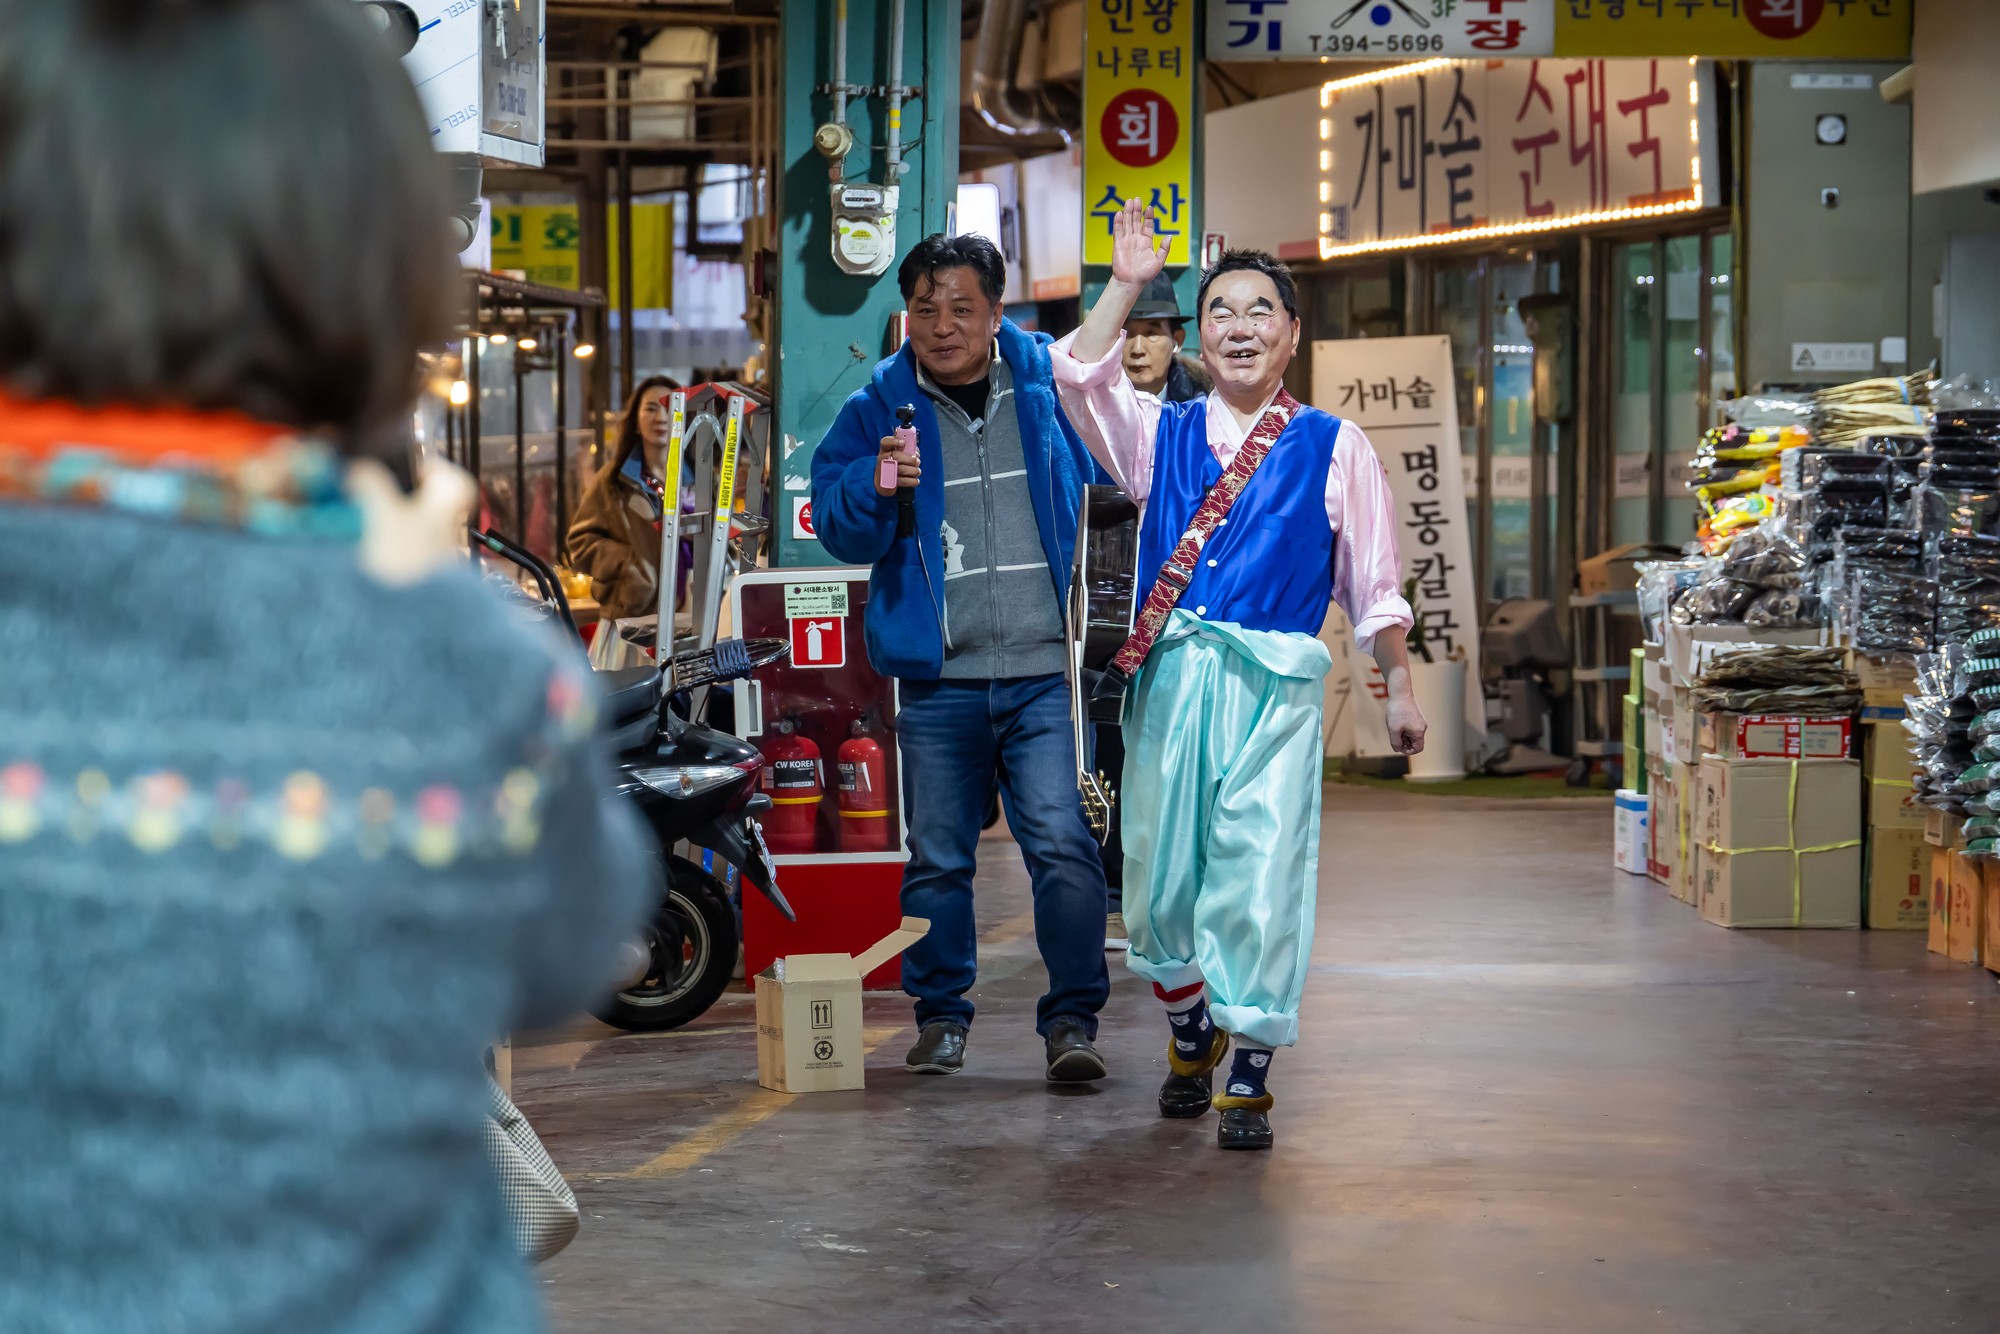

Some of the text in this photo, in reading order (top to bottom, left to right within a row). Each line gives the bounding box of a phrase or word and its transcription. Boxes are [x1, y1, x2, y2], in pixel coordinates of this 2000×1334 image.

[1101, 0, 1179, 34] 인왕
[1096, 46, 1181, 78] 나루터
[442, 104, 478, 129] STEEL
[1117, 100, 1159, 158] 회
[1352, 59, 1670, 241] 가마솥 순대국
[1090, 183, 1186, 237] 수산
[1339, 375, 1435, 412] 가마솥
[723, 464, 733, 480] STEP
[720, 482, 730, 507] LADDER
[803, 585, 840, 593] 서대문소방서
[775, 759, 815, 768] CW KOREA
